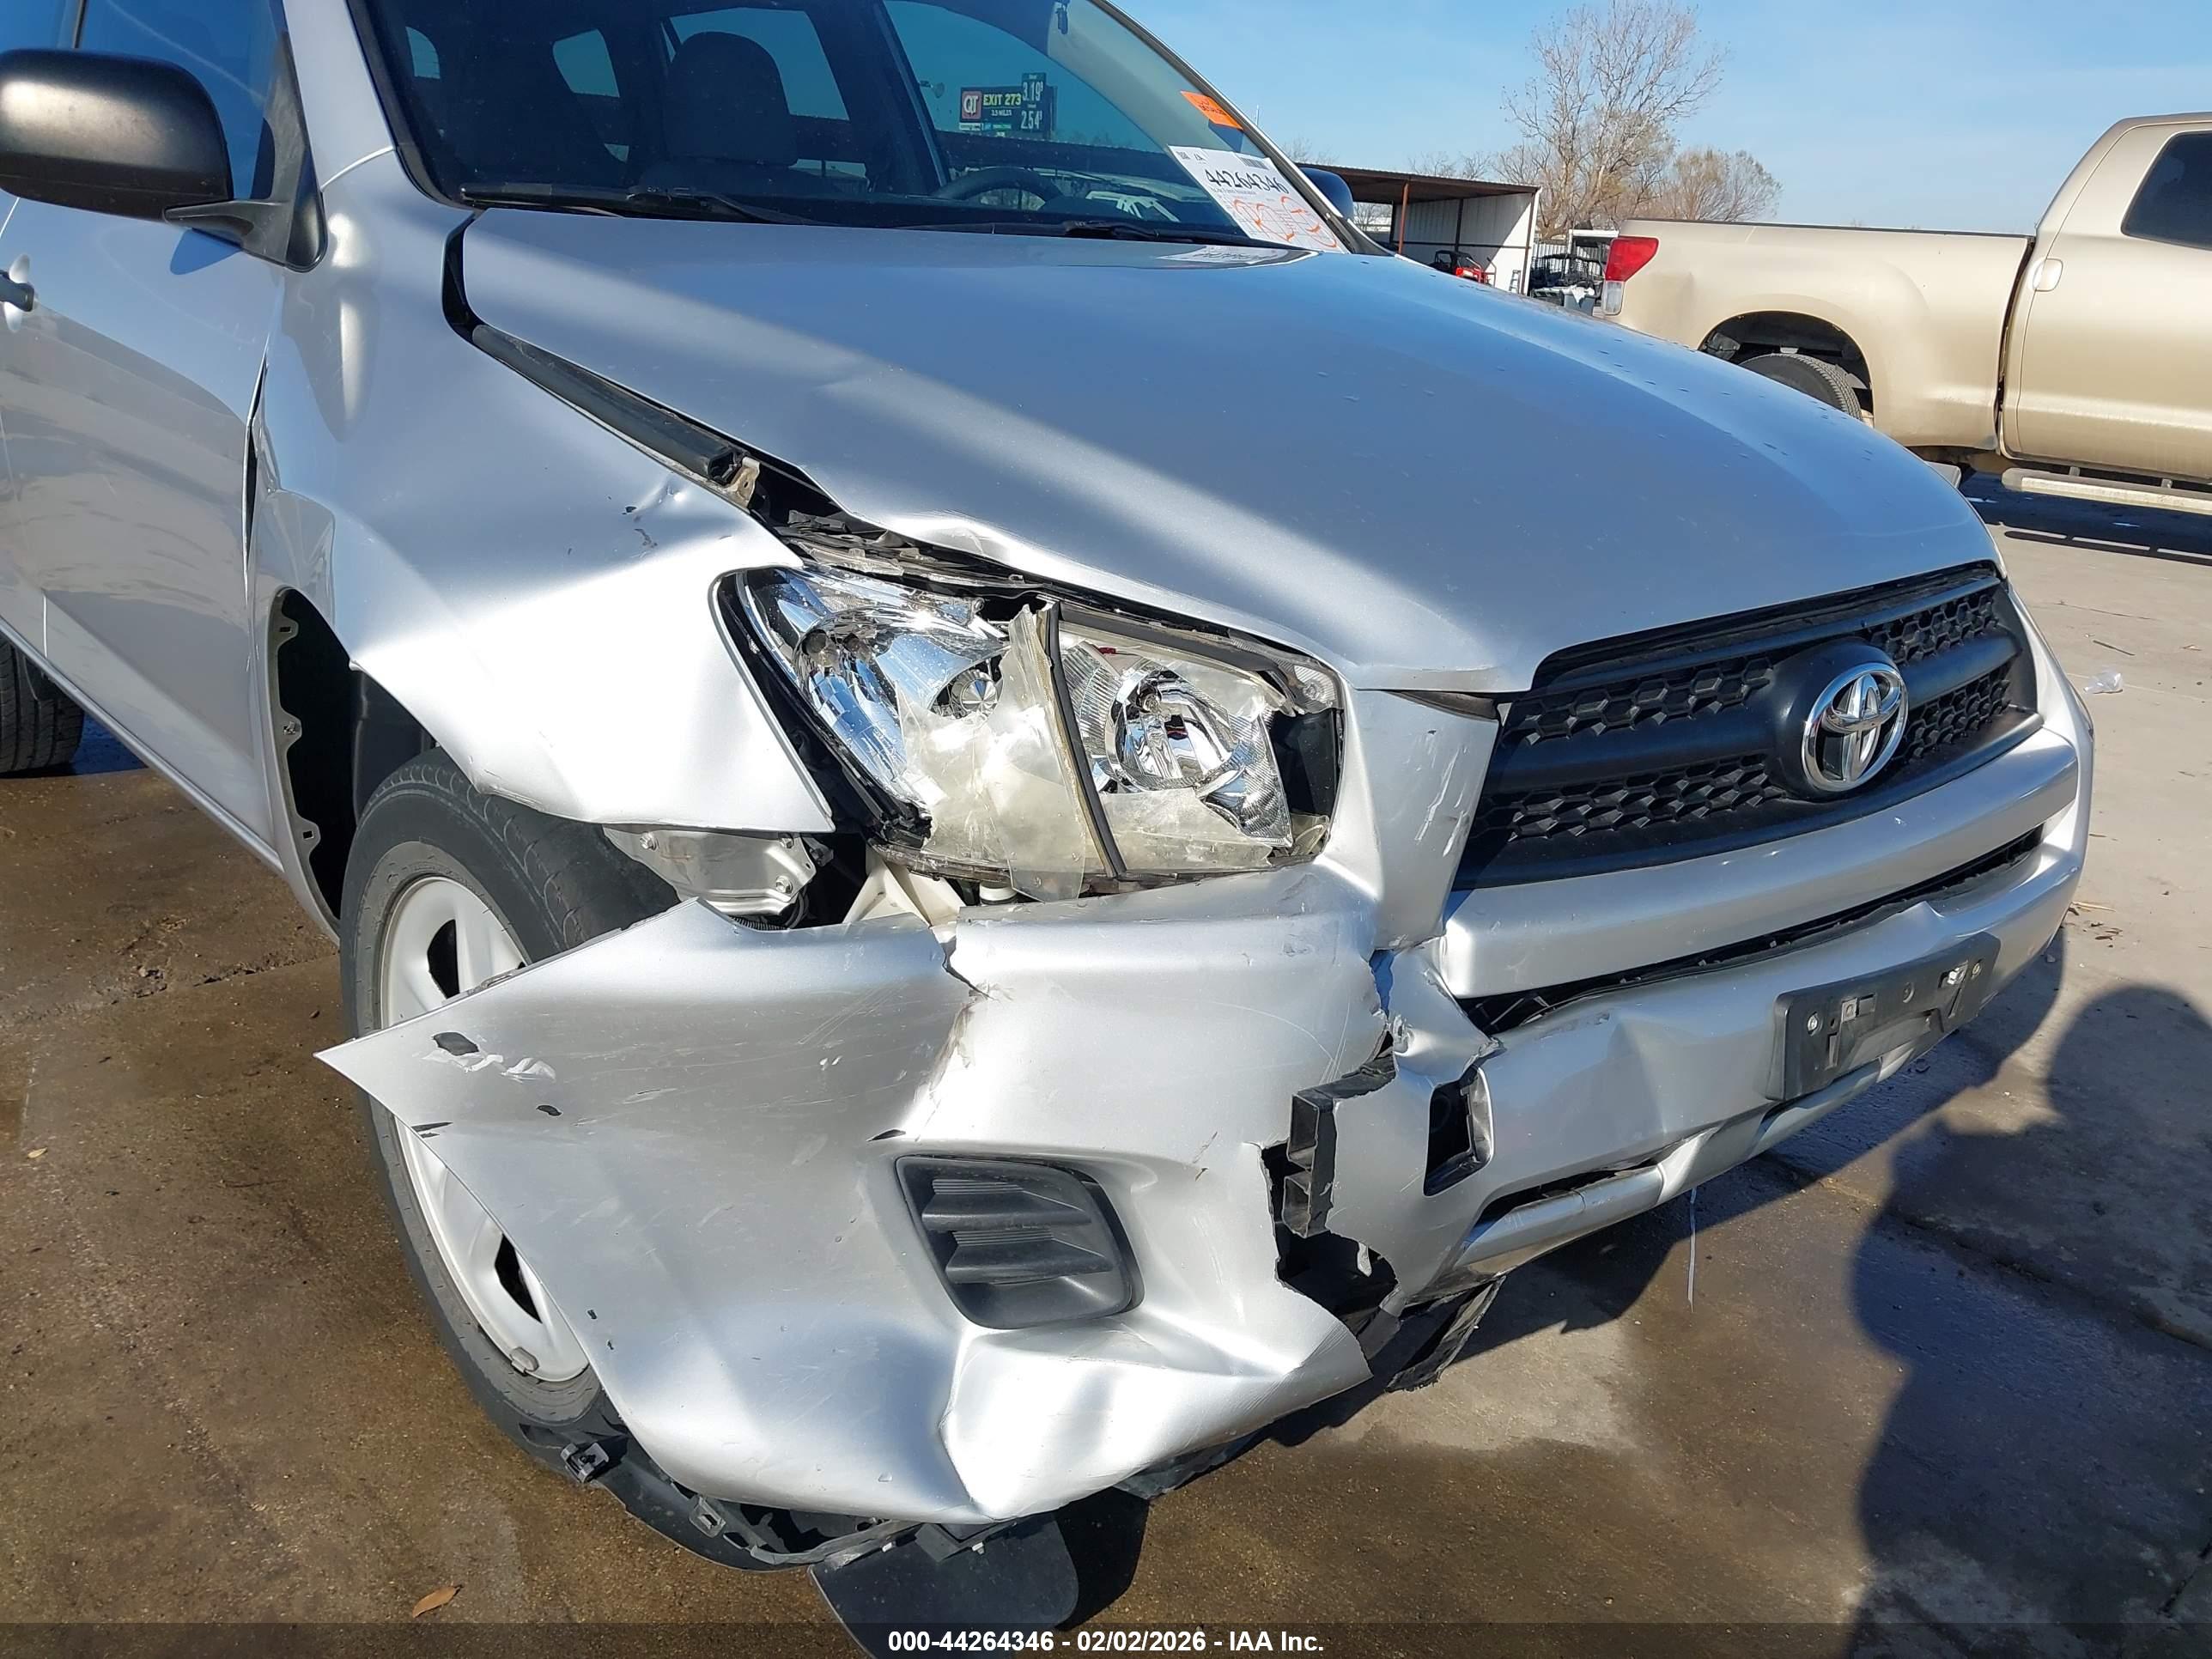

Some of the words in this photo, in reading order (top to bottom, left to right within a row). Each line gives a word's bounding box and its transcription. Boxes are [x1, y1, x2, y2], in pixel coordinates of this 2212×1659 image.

[963, 94, 979, 113] QT
[983, 93, 1002, 106] EXIT
[1004, 93, 1022, 106] 273
[1204, 168, 1290, 194] 44264346
